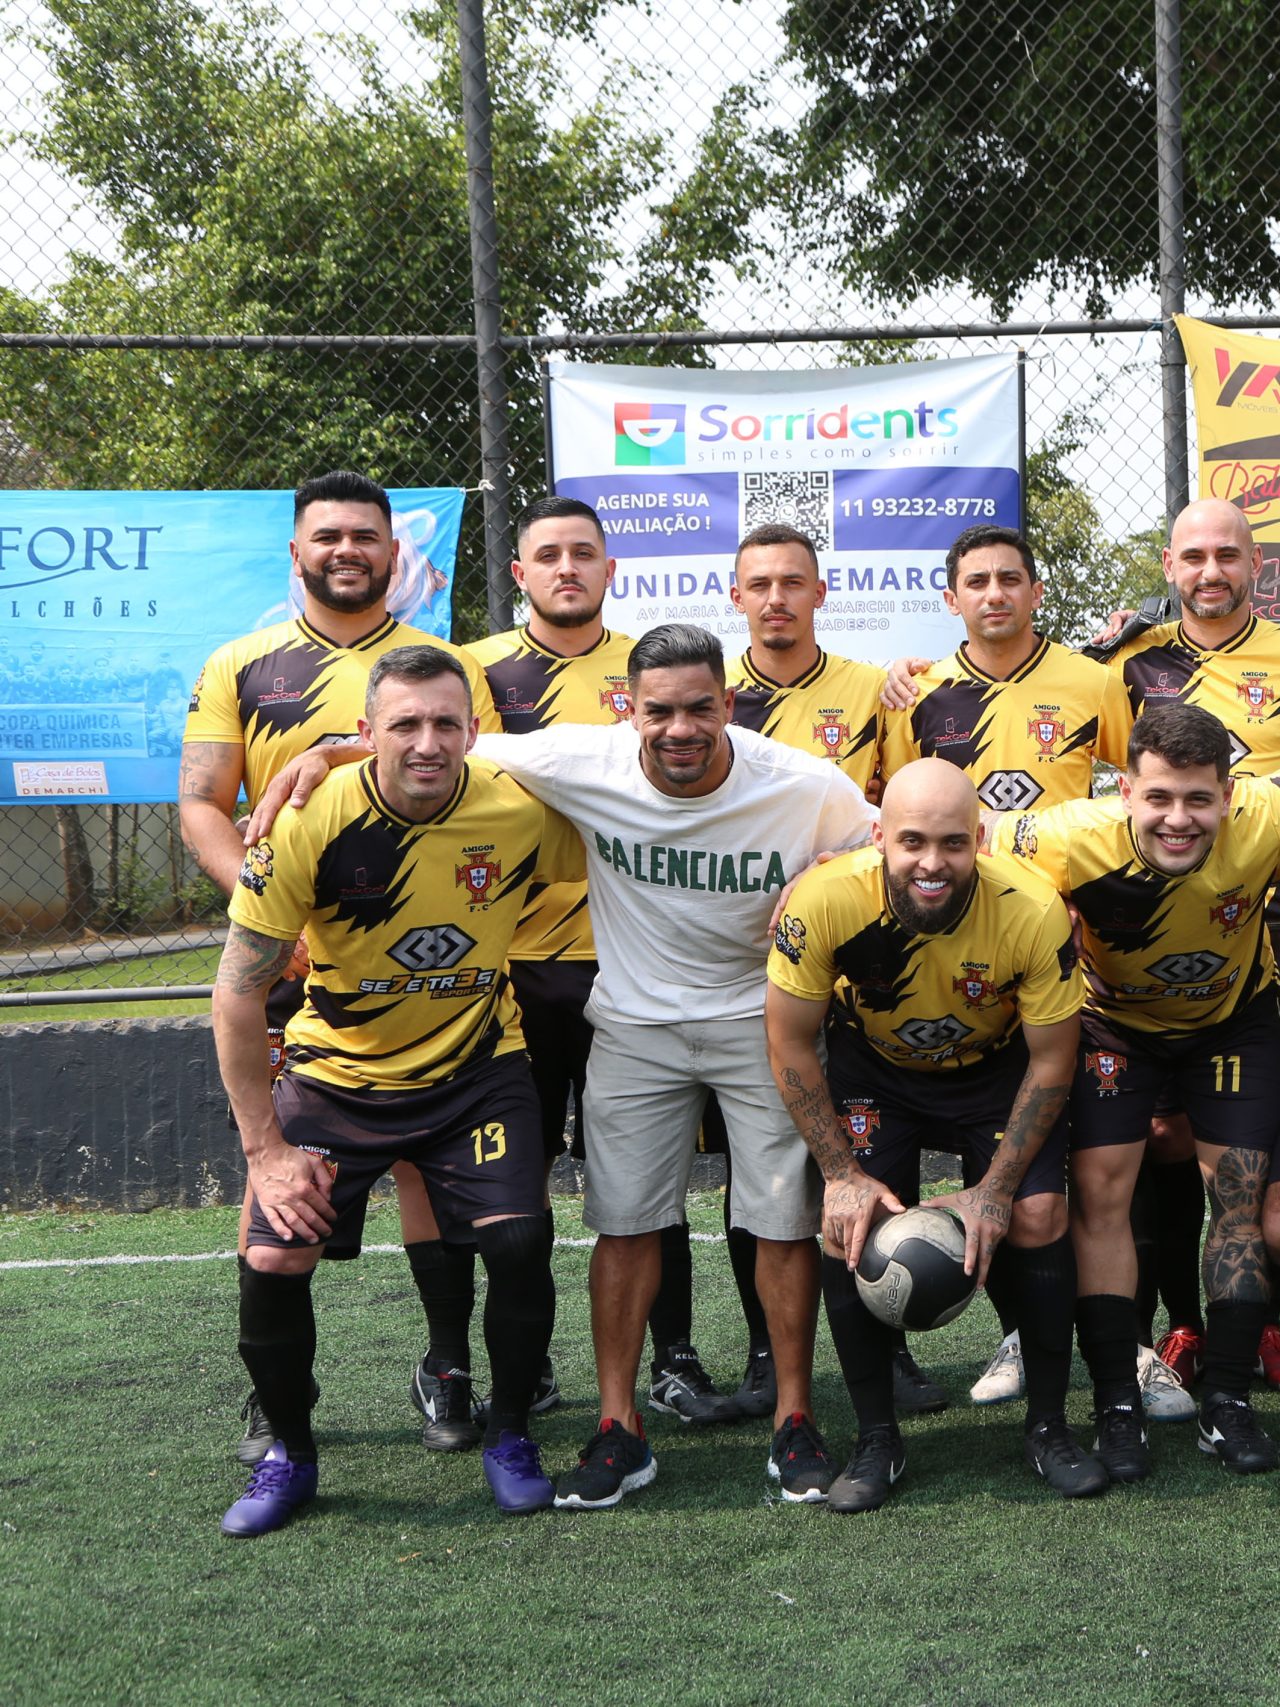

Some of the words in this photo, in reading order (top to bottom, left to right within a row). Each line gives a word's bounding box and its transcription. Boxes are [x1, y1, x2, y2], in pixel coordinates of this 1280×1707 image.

[698, 401, 959, 442] Sorridents
[698, 446, 793, 463] simples
[810, 447, 871, 459] como
[596, 493, 667, 511] AGENDE
[672, 493, 710, 508] SUA
[840, 499, 863, 517] 11
[872, 497, 996, 517] 93232-8778
[604, 513, 700, 536] AVALIAÇÃO
[0, 526, 164, 571] FORT
[611, 571, 737, 600] UNIDA
[826, 566, 947, 592] EMARC
[636, 607, 660, 621] AV
[665, 604, 719, 619] MARIA
[902, 600, 941, 613] 1791
[41, 732, 134, 749] EMPRESAS
[22, 786, 105, 795] DEMARCHI
[461, 844, 495, 853] AMIGOS
[594, 831, 787, 894] BALENCIAGA
[960, 961, 990, 970] AMIGOS
[359, 973, 424, 994] SE7E
[428, 967, 497, 990] TR3S
[1210, 1055, 1241, 1092] 11
[298, 1144, 331, 1156] AMIGOS
[470, 1122, 507, 1166] 13
